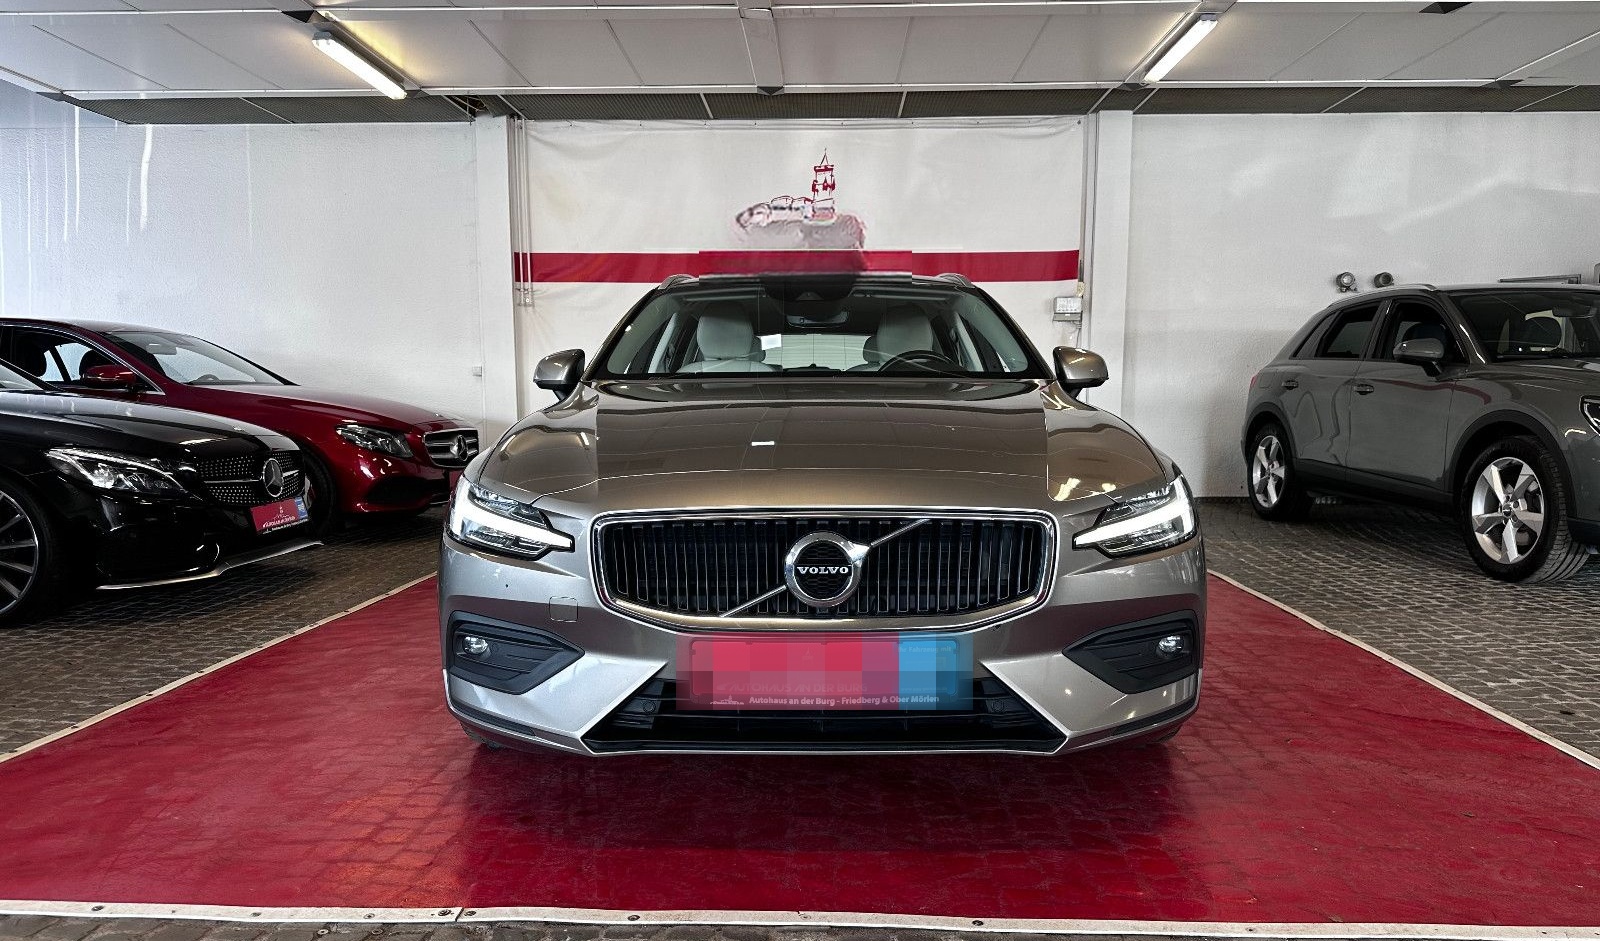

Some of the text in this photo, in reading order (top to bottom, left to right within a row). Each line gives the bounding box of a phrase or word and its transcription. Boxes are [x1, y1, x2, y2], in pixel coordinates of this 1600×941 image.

[797, 566, 849, 574] VOLVO
[729, 683, 791, 692] AUTOHAUS
[814, 683, 834, 692] DER
[837, 683, 868, 692] BURG
[749, 696, 787, 704] Autohaus
[800, 696, 814, 704] der
[815, 697, 835, 706] Burg
[841, 696, 880, 706] Friedberg
[889, 695, 909, 703] Ober
[910, 694, 939, 703] Mörlen
